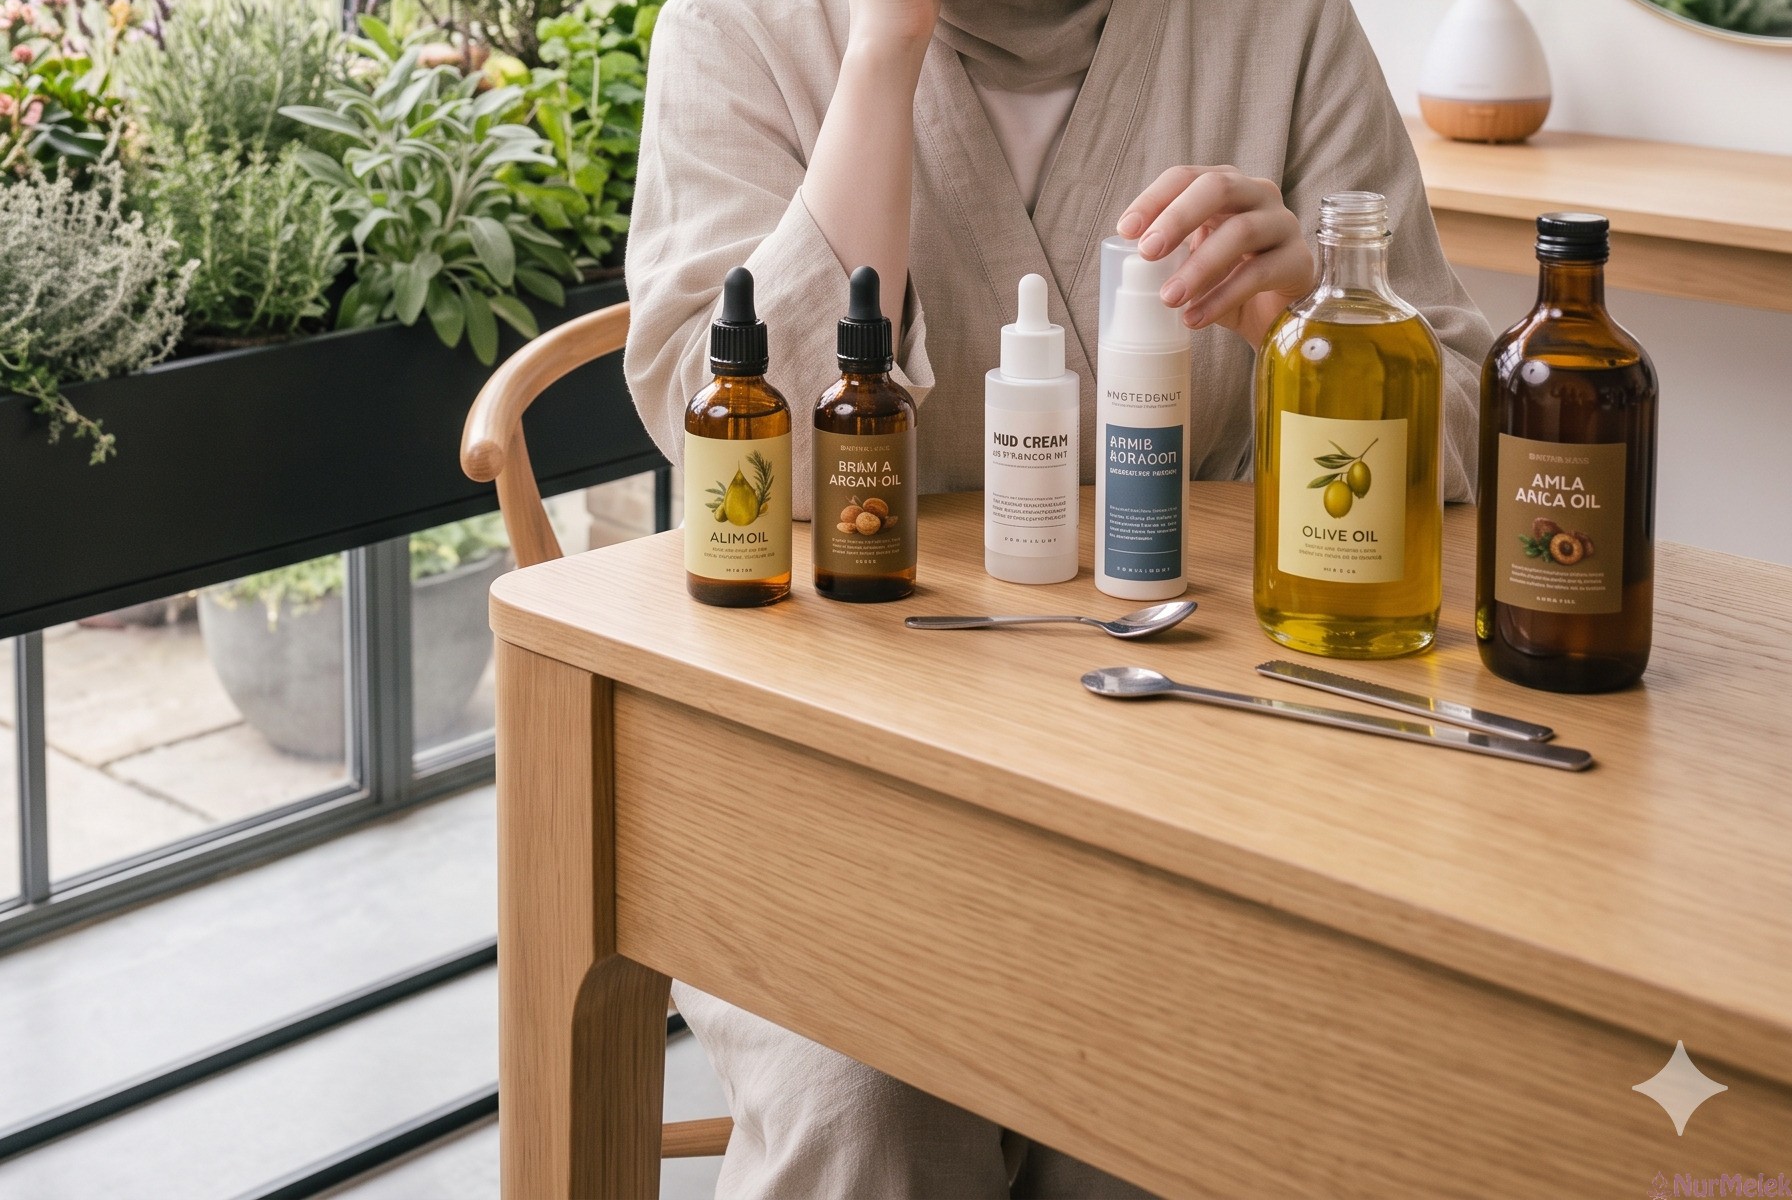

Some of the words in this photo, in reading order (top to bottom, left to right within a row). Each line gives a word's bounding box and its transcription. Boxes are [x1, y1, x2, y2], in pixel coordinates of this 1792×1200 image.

[1023, 434, 1068, 449] CREAM
[829, 474, 877, 488] ARGAN
[881, 475, 902, 487] OIL
[1531, 473, 1585, 491] AMLA
[1570, 493, 1601, 509] OIL
[1302, 525, 1348, 542] OLIVE
[1352, 530, 1379, 543] OIL
